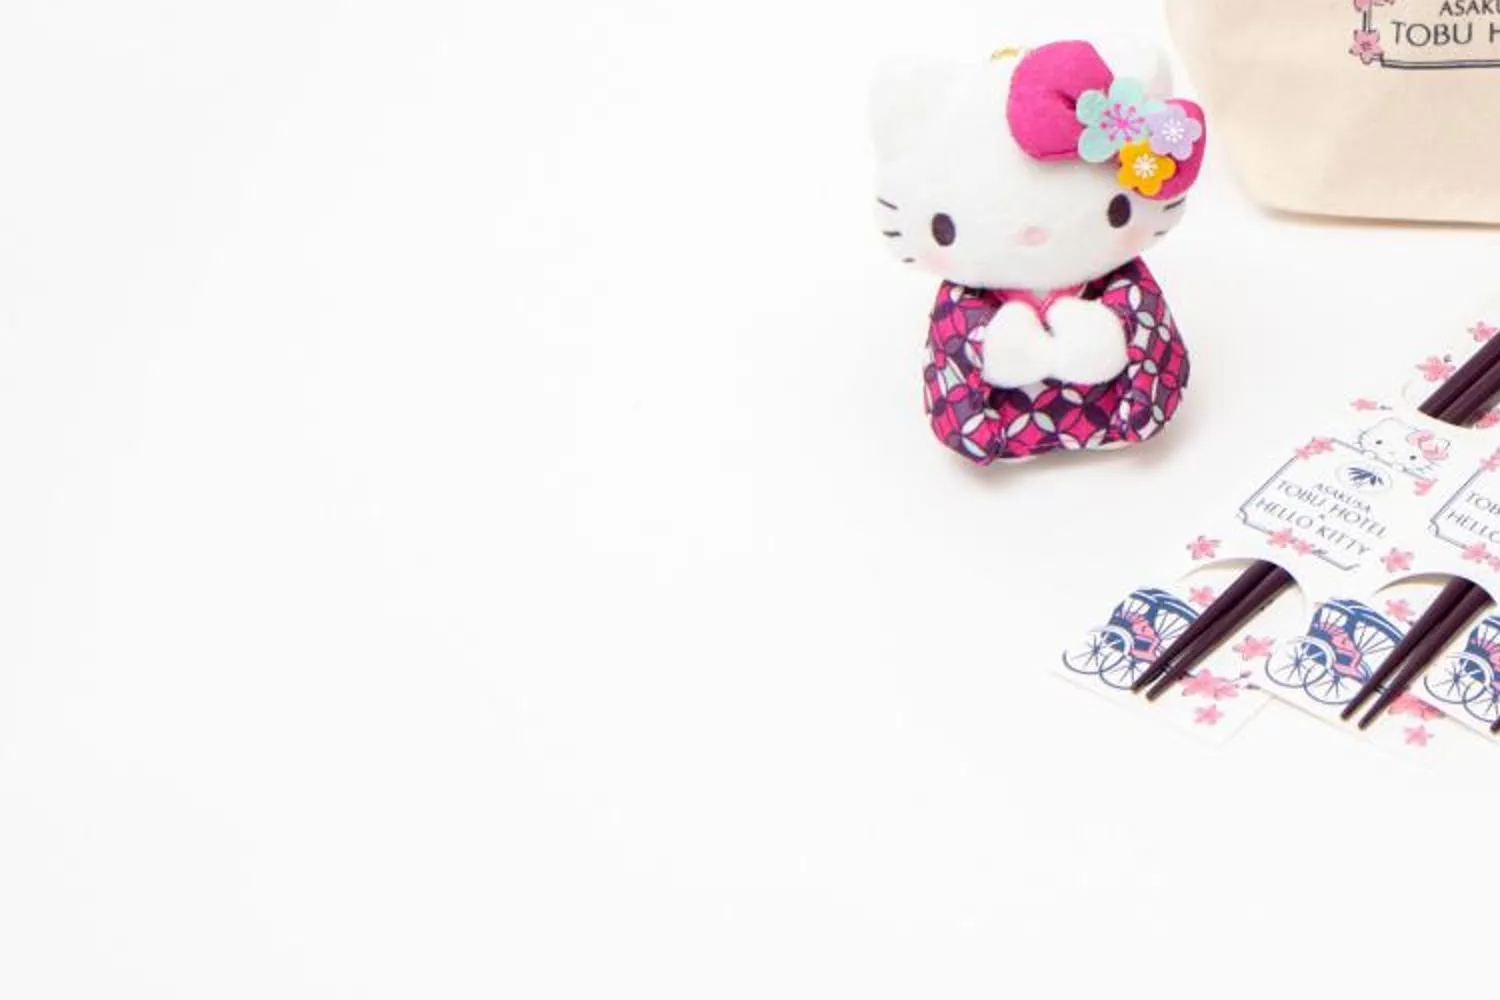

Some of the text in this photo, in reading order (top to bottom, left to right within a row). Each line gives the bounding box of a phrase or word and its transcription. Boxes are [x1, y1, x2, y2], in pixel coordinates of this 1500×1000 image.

[1391, 20, 1473, 47] TOBU
[1256, 498, 1371, 555] HELLO KITTY
[1278, 480, 1387, 538] TOBU HOTEL
